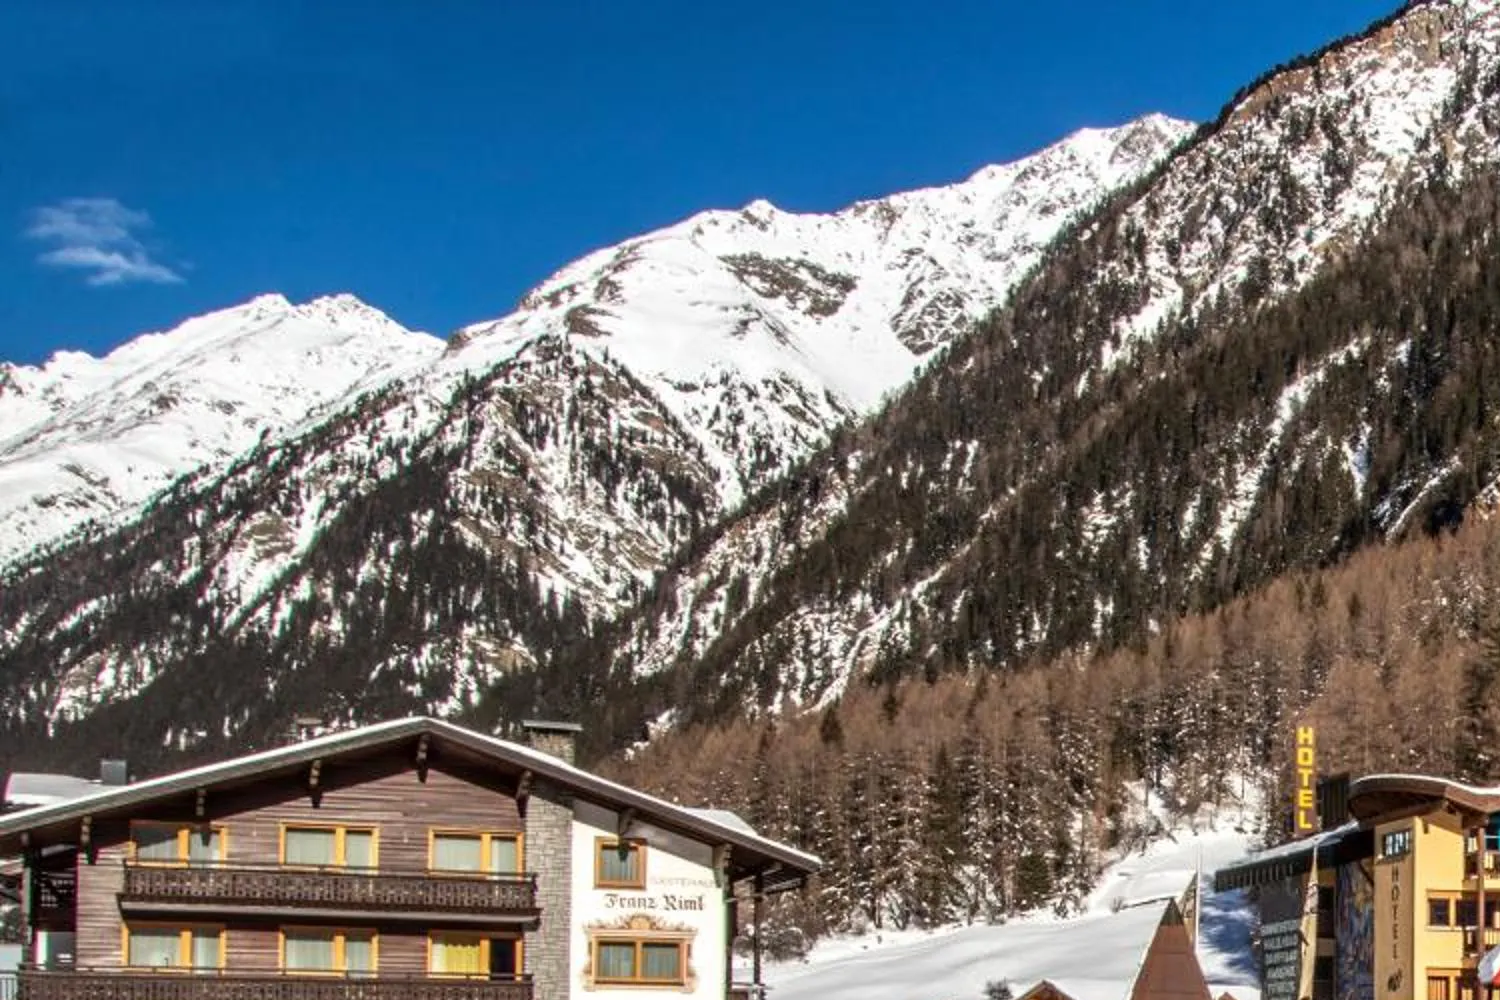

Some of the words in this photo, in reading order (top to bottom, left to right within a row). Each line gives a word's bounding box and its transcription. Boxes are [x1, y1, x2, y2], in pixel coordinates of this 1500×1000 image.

[1297, 726, 1314, 829] HOTEL
[604, 893, 658, 909] Franz
[1391, 864, 1401, 961] HOTEL
